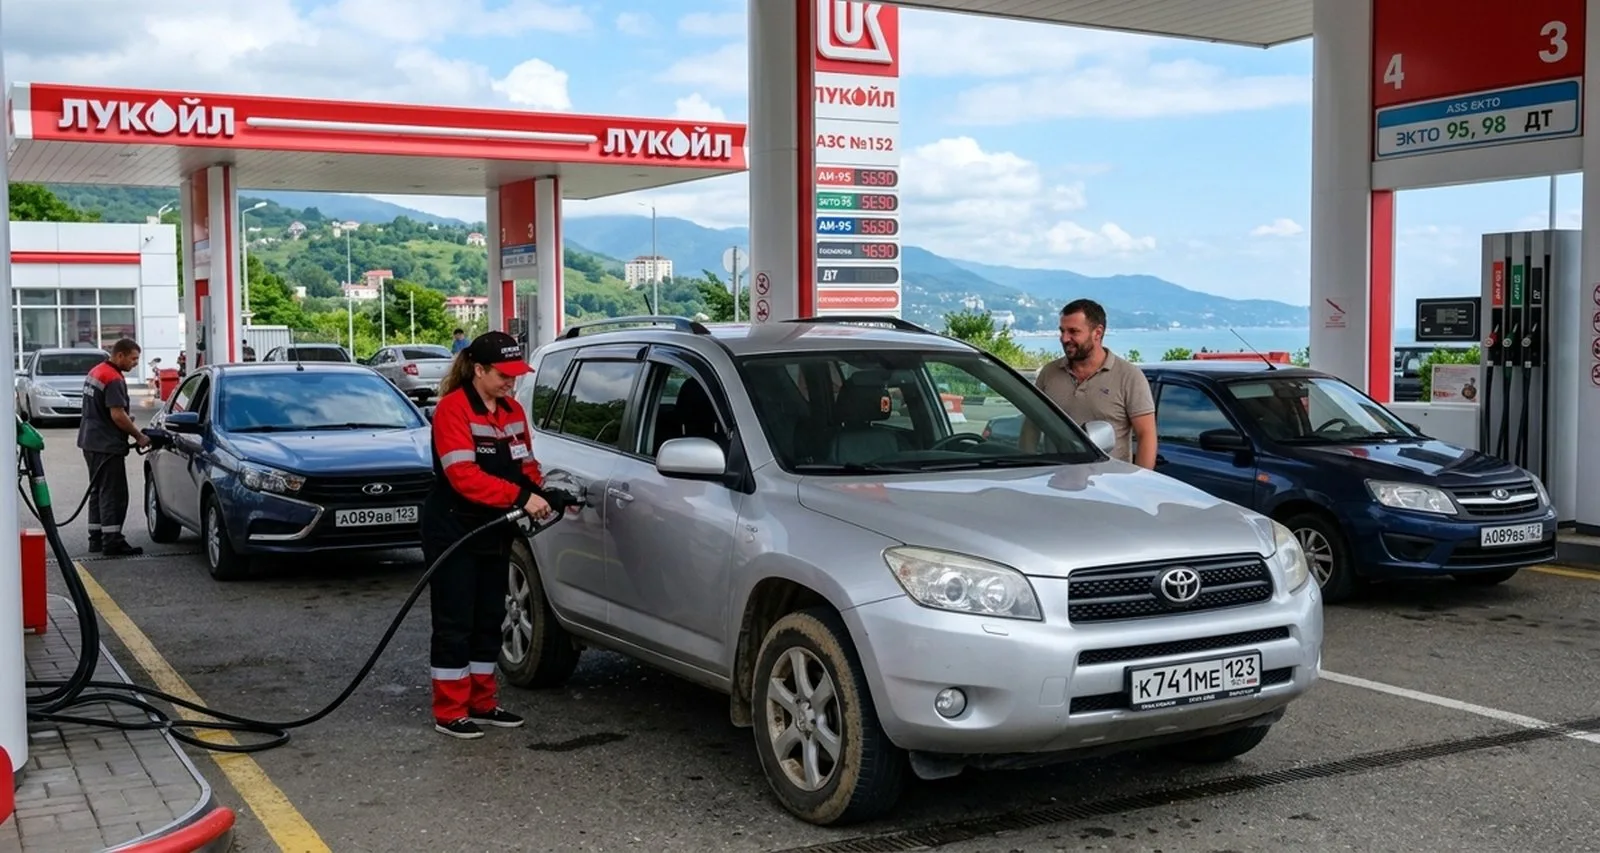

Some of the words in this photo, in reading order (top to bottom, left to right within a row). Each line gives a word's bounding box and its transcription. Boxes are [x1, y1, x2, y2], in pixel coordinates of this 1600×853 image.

[1537, 20, 1568, 63] 3
[1383, 53, 1404, 90] 4
[58, 97, 235, 137] ЛУКОЙЛ
[1447, 120, 1476, 140] 95,
[1482, 115, 1506, 135] 98
[1524, 109, 1553, 133] ДТ
[603, 126, 732, 159] ЛУКОЙЛ
[816, 134, 846, 149] АЗС
[850, 136, 893, 151] №152
[396, 507, 415, 518] 123
[1139, 667, 1221, 699] К741МЕ
[1225, 657, 1255, 679] 123
